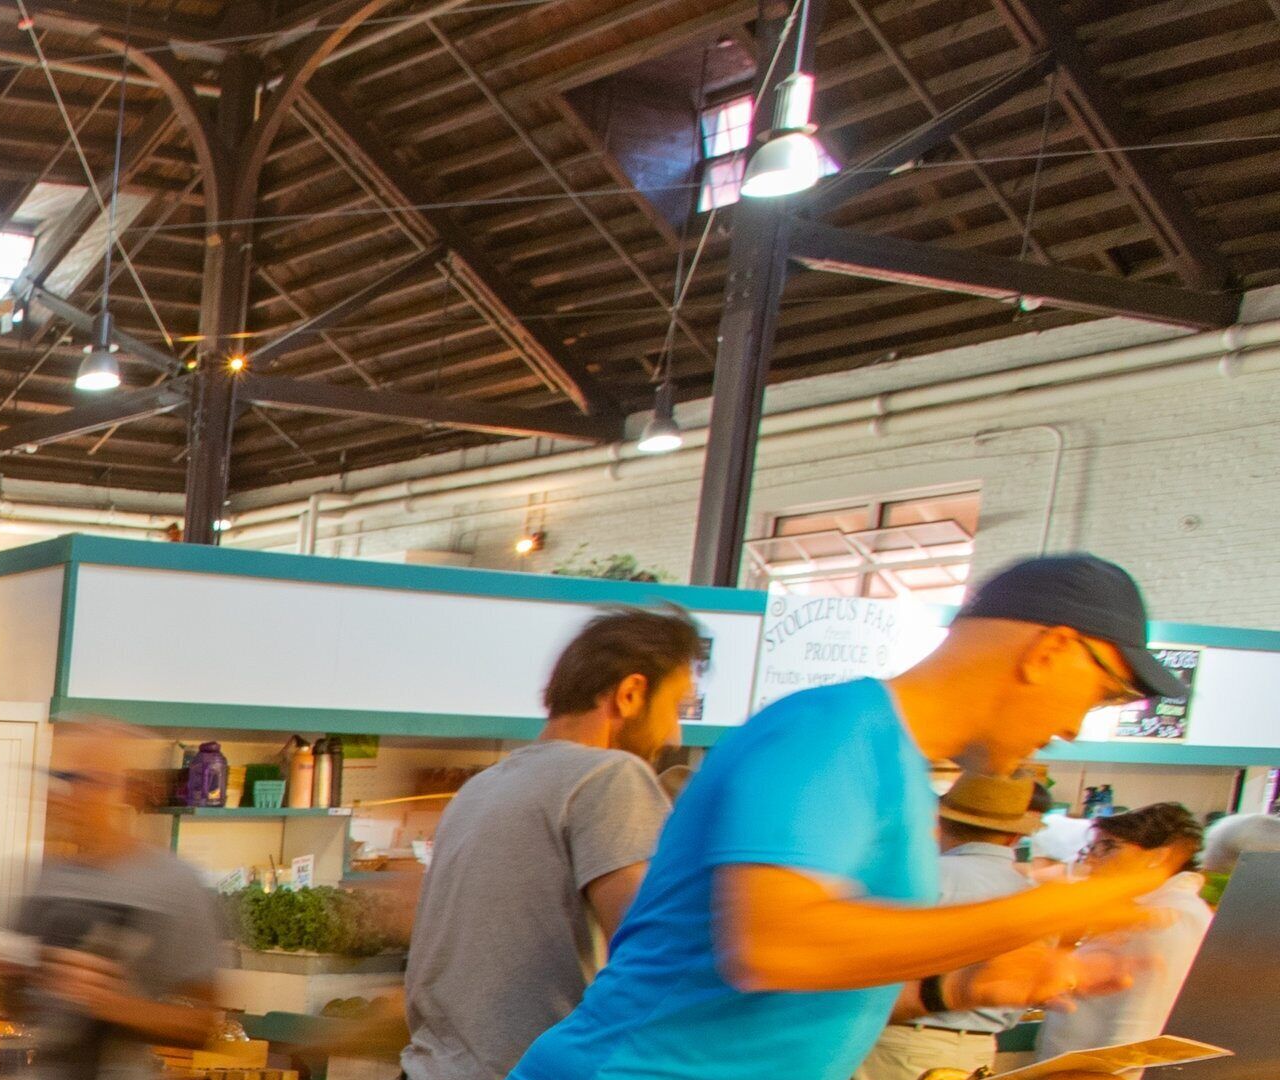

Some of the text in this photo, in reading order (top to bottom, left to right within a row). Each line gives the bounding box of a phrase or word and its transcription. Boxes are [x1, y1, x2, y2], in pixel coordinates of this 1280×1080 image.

[764, 597, 895, 652] STOLTZFUS FAR
[804, 642, 868, 663] PRODUCE
